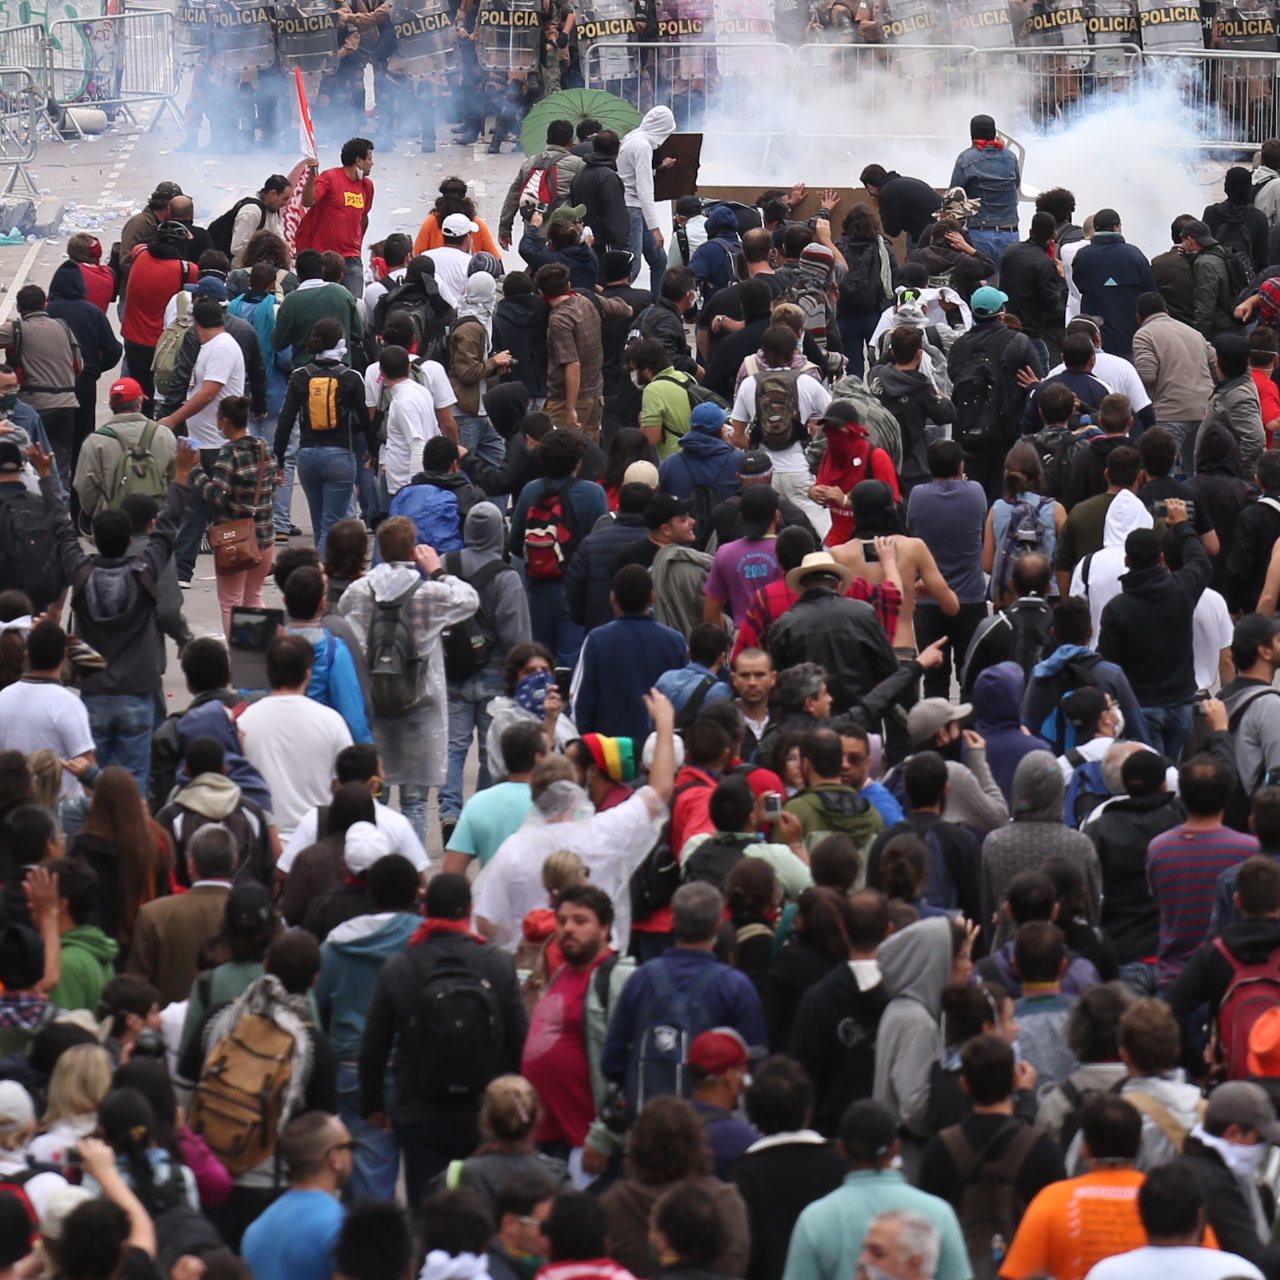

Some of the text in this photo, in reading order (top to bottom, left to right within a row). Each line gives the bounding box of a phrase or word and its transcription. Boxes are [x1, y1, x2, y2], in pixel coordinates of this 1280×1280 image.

[212, 7, 269, 29] POLICIA
[277, 13, 335, 34] POLICIA
[394, 11, 452, 39] POLICIA
[481, 11, 540, 26] POLICIA
[882, 13, 938, 39] POLICIA
[1028, 7, 1083, 31] POLICIA
[1086, 16, 1138, 32] OLICIA
[1141, 6, 1200, 27] POLICIA
[577, 19, 636, 40] POLICIA
[1219, 19, 1274, 37] POLICIA
